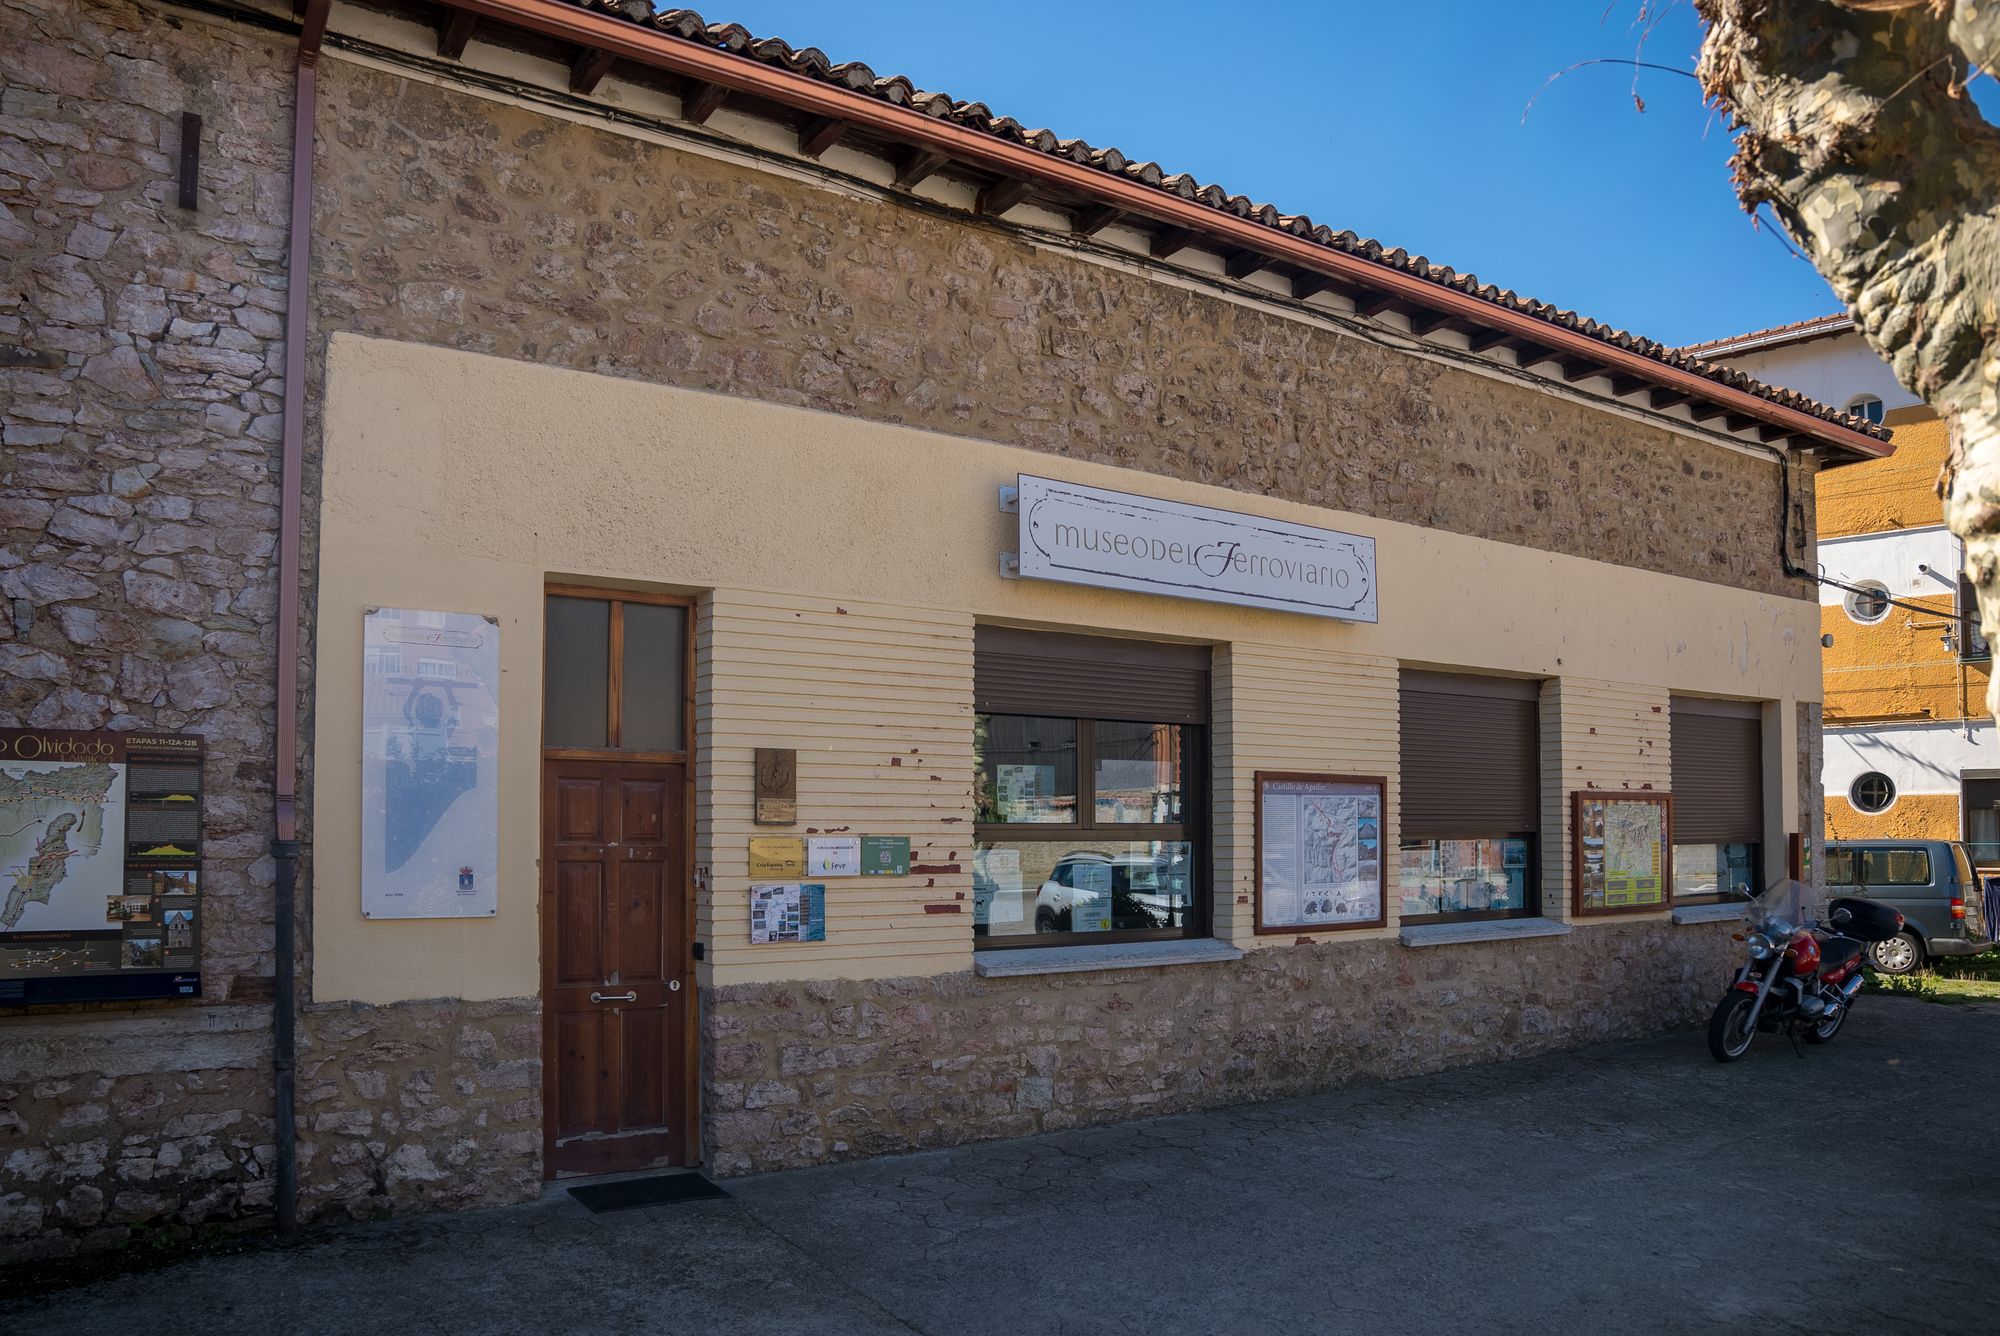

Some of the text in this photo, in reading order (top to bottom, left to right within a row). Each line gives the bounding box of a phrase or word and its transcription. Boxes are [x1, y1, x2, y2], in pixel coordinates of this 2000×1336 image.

[126, 737, 157, 745] ETAPAS
[15, 735, 114, 759] Olvidado
[1272, 783, 1296, 791] Castillo
[1304, 784, 1326, 793] Aguilar
